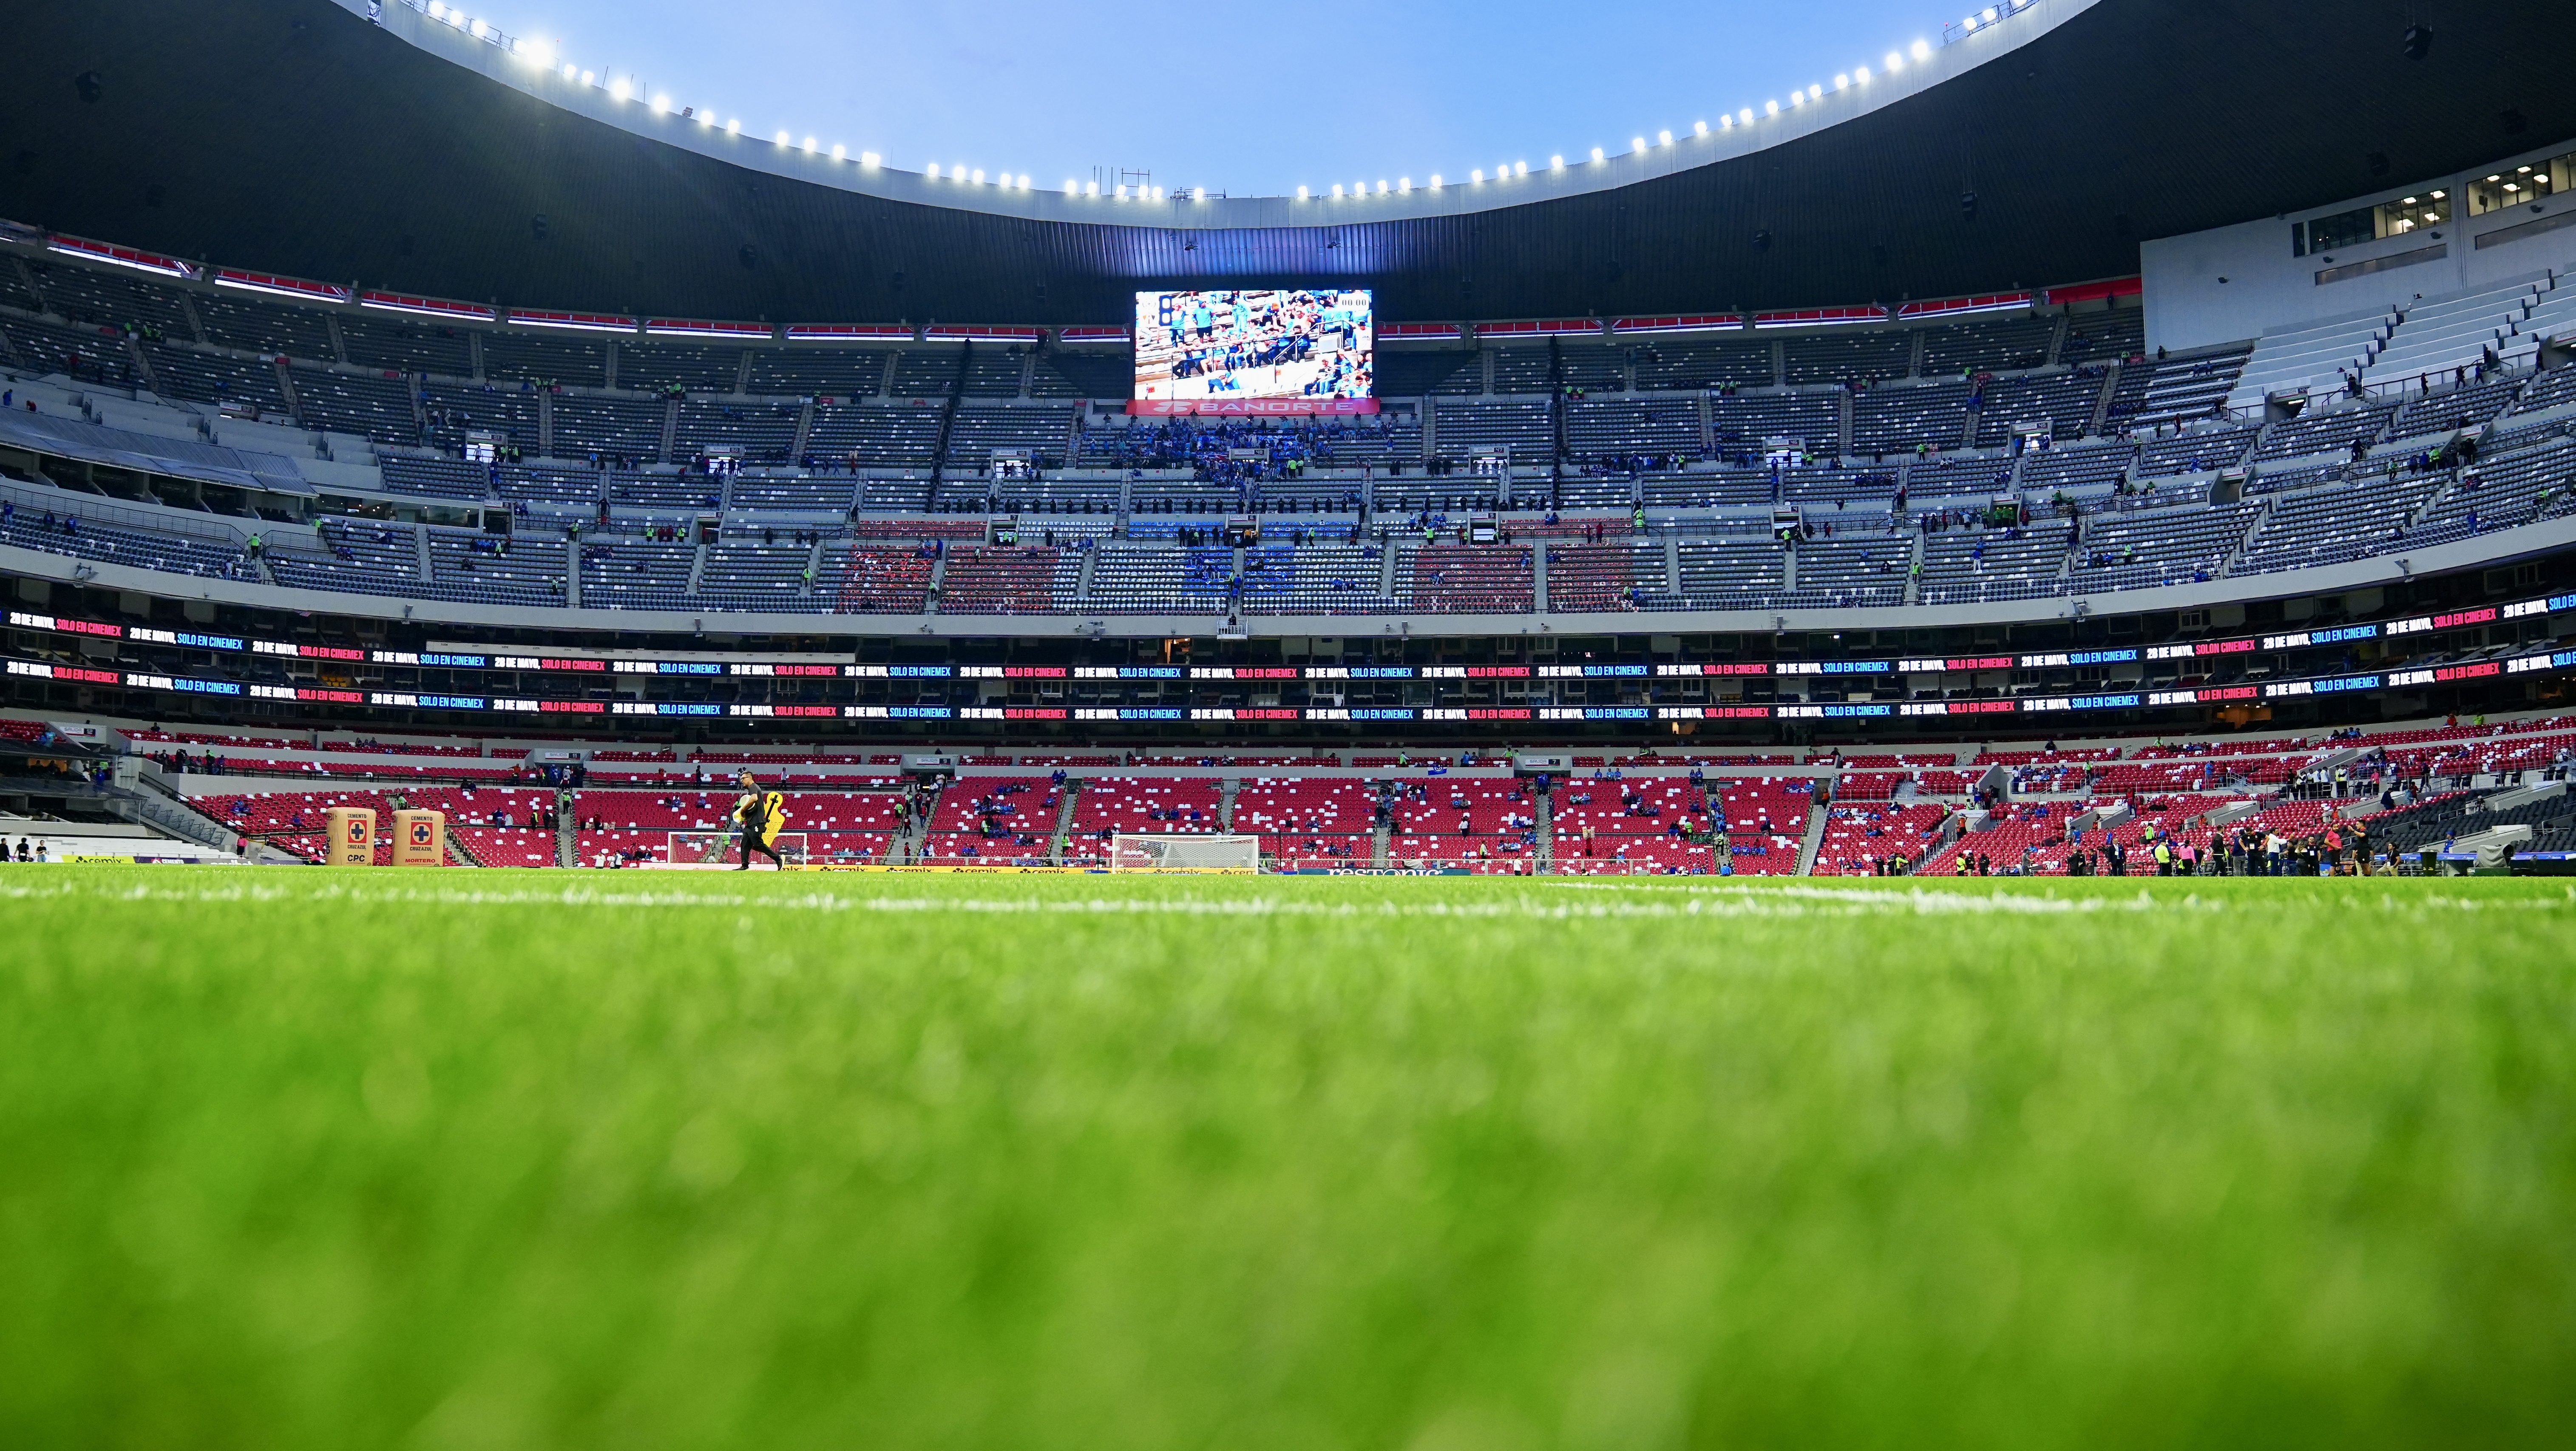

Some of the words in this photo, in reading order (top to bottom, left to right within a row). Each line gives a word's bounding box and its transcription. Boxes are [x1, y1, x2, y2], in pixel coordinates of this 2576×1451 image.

[1199, 402, 1354, 411] BANORTE
[21, 614, 31, 626] DE
[32, 615, 56, 630] MAYO,
[57, 619, 75, 631] SOLO
[76, 621, 87, 632] EN
[88, 623, 121, 636] CINEMEX
[2159, 647, 2168, 658] DE
[2170, 645, 2194, 657] MAYO,
[2221, 640, 2255, 653] CINEMEX
[384, 652, 394, 662] DE
[395, 653, 419, 664] MAYO,
[420, 654, 440, 664] SOLO
[440, 655, 451, 665] EN
[451, 656, 485, 666] CINEMEX
[741, 665, 750, 674] DE
[752, 665, 774, 676] MAYO,
[776, 666, 793, 674] SOLO
[794, 666, 804, 675] EN
[806, 666, 836, 675] CINEMEX
[1085, 668, 1094, 677] DE
[1096, 668, 1118, 678] MAYO,
[1120, 668, 1138, 677] SOLO
[1138, 668, 1148, 677] EN
[1149, 668, 1180, 677] CINEMEX
[1433, 667, 1442, 677] DE
[1444, 667, 1466, 678] MAYO,
[1468, 667, 1485, 676] SOLO
[1487, 667, 1496, 676] EN
[1498, 667, 1529, 676] CINEMEX
[1787, 663, 1797, 673] DE
[1799, 663, 1822, 674] MAYO,
[1824, 663, 1843, 672] SOLO
[1844, 663, 1855, 672] EN
[1855, 662, 1889, 672] CINEMEX
[2400, 672, 2409, 685] DE
[2411, 670, 2435, 683] MAYO,
[2437, 668, 2454, 680] SOLO
[2456, 667, 2466, 678] EN
[2467, 663, 2499, 677] CINEMEX
[138, 675, 148, 686] DE
[149, 677, 173, 690] MAYO,
[175, 679, 194, 690] SOLO
[194, 681, 206, 691] EN
[206, 682, 240, 694] CINEMEX
[505, 700, 514, 710] DE
[514, 700, 539, 711] MAYO,
[541, 702, 559, 711] SOLO
[560, 702, 570, 711] EN
[572, 703, 604, 712] CINEMEX
[1912, 704, 1921, 714] DE
[1923, 703, 1947, 714] MAYO,
[1949, 703, 1967, 713] SOLO
[1969, 703, 1979, 712] EN
[1981, 701, 2014, 712] CINEMEX
[856, 707, 864, 717] DE
[866, 707, 888, 718] MAYO,
[890, 707, 908, 717] SOLO
[908, 708, 919, 717] EN
[919, 708, 950, 717] CINEMEX
[1202, 709, 1211, 719] DE
[1212, 709, 1234, 720] MAYO,
[1236, 710, 1254, 718] SOLO
[1255, 710, 1264, 718] EN
[1266, 709, 1297, 718] CINEMEX
[1551, 709, 1560, 719] DE
[1561, 709, 1584, 720] MAYO,
[1586, 709, 1604, 718] SOLO
[1605, 709, 1615, 718] EN
[1616, 708, 1648, 718] CINEMEX
[347, 854, 366, 862] CPC
